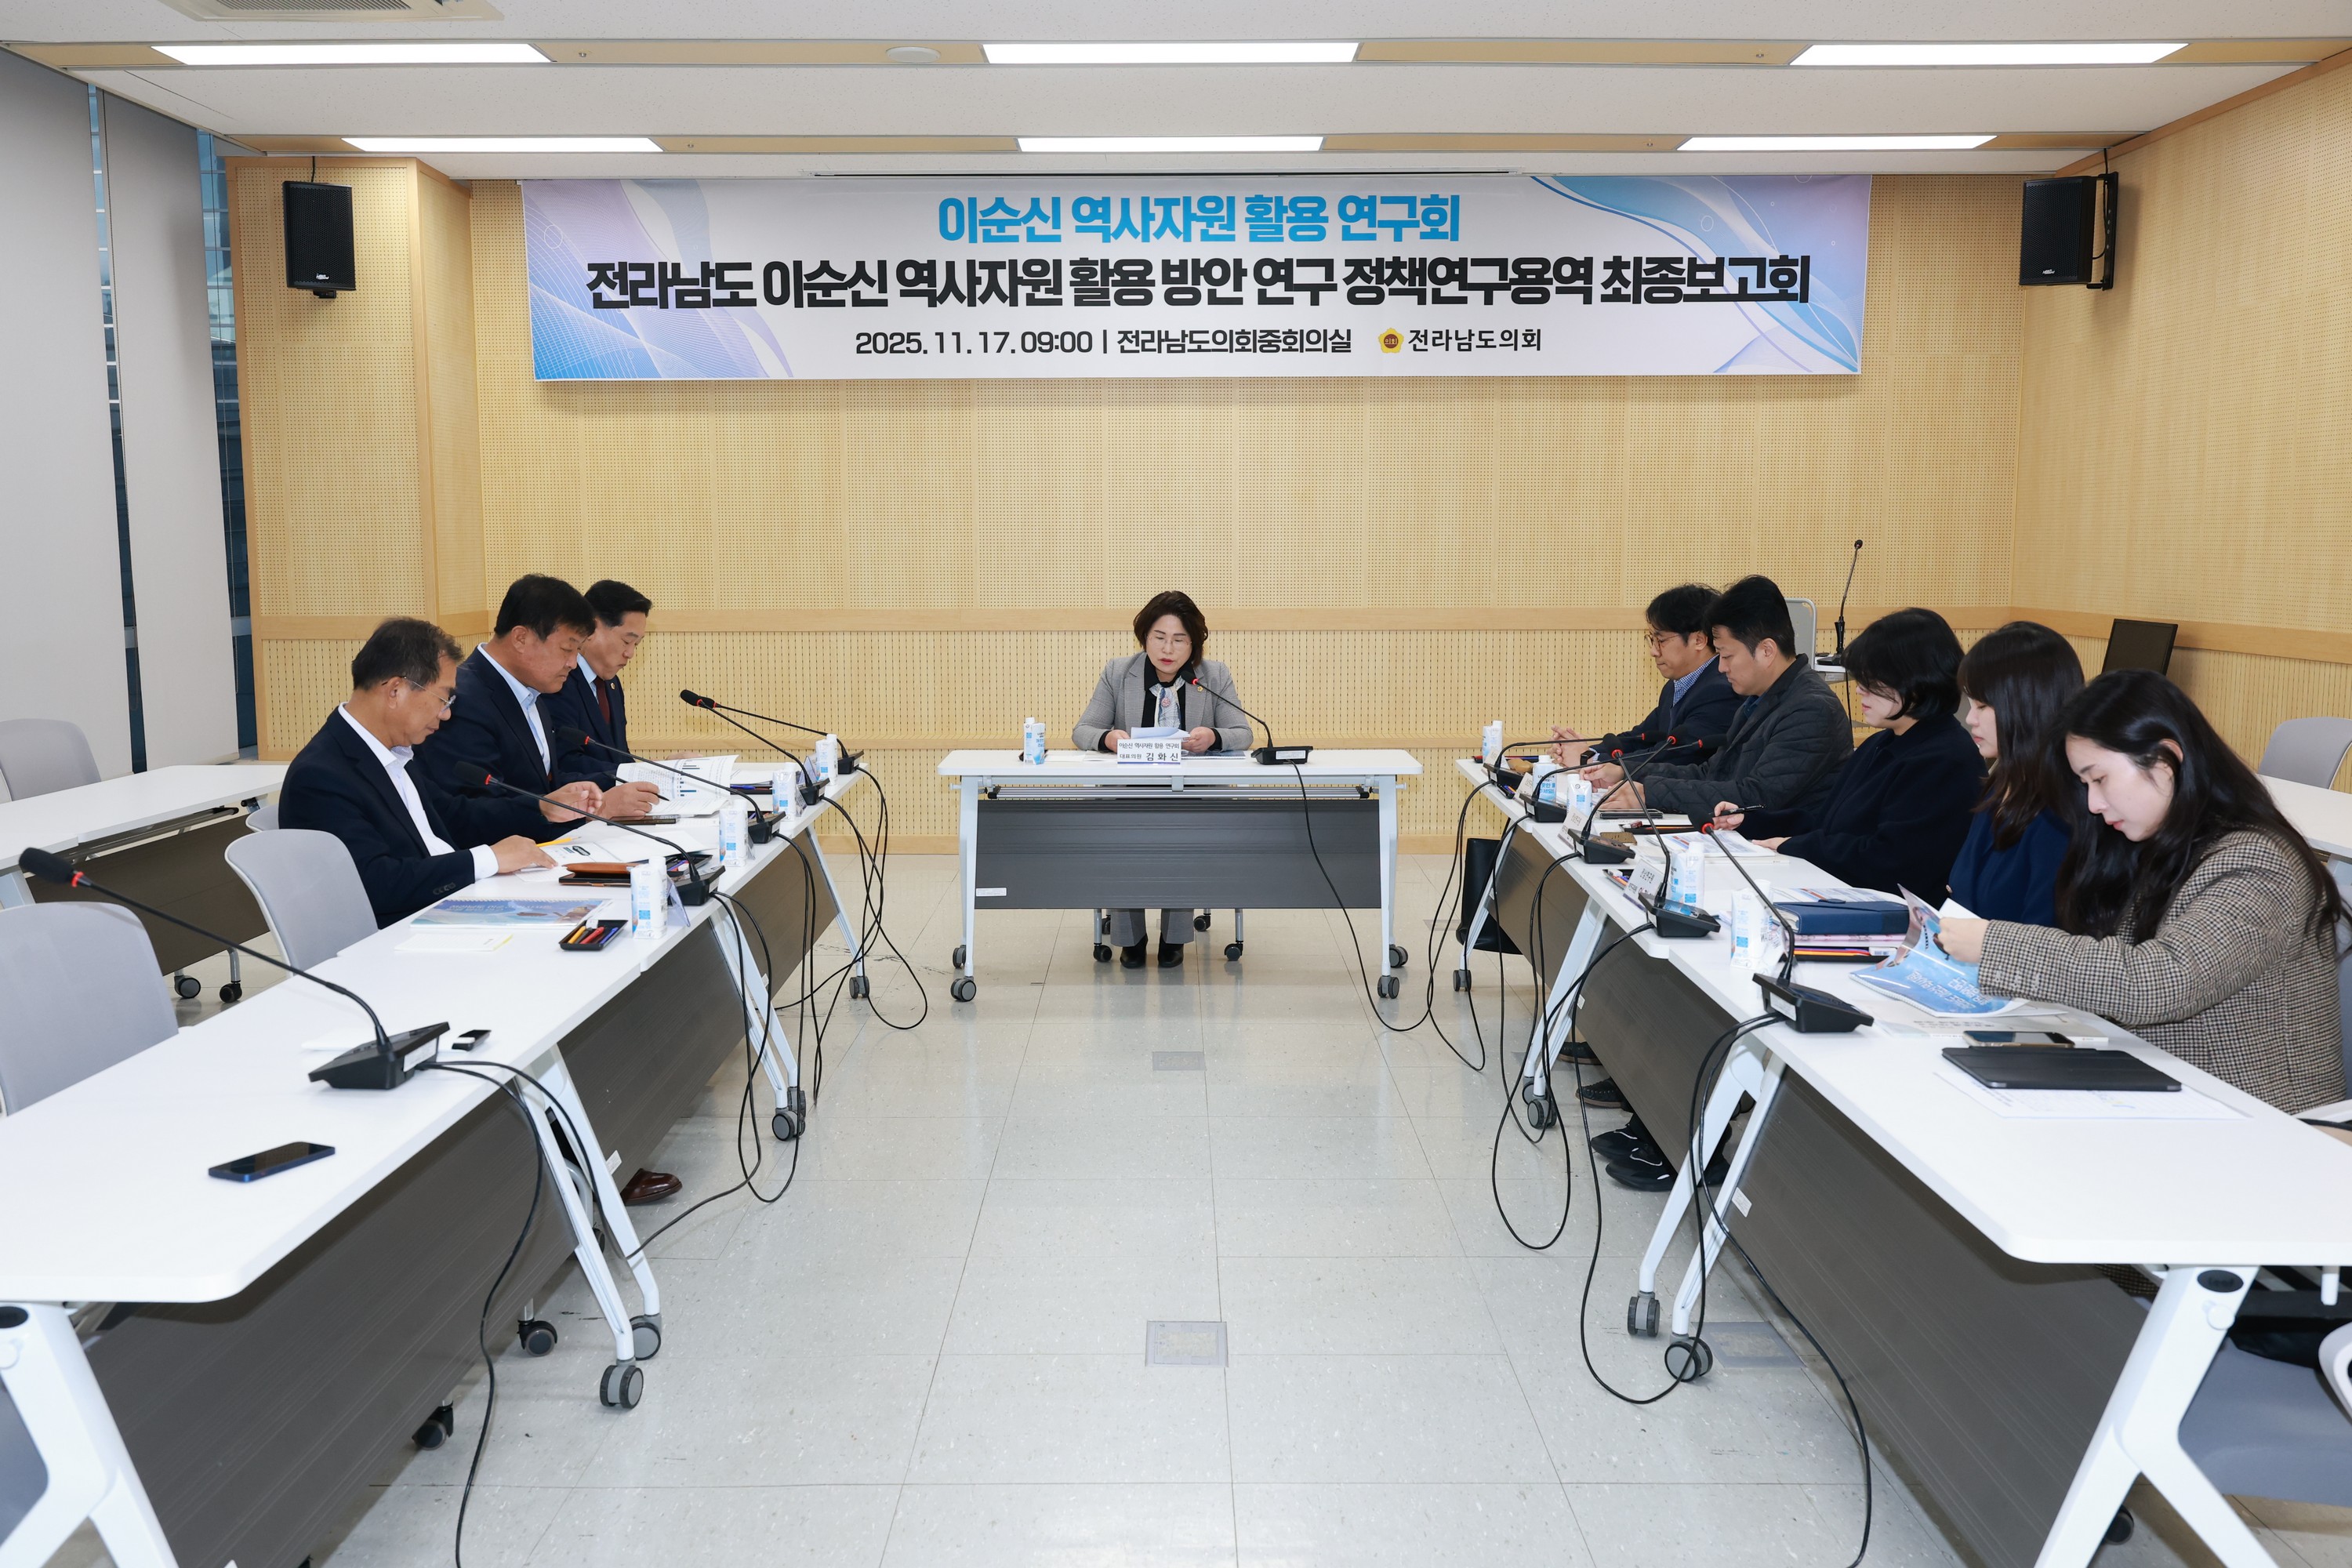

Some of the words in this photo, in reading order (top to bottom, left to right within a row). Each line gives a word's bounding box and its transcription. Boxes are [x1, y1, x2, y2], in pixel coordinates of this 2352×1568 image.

[938, 196, 1062, 244] 이순신
[1071, 195, 1236, 243] 역사자원
[1244, 194, 1329, 242] 활용
[1338, 194, 1461, 242] 연구회
[586, 261, 757, 310] 전라남도
[763, 260, 888, 308] 이순신
[895, 258, 1063, 308] 역사자원
[1069, 257, 1156, 307] 활용
[1161, 258, 1248, 307] 방안
[1253, 257, 1338, 307] 연구
[1342, 256, 1594, 306] 정책연구용역
[1600, 254, 1810, 305] 최종보고회
[1117, 328, 1352, 354] 전라남도의회중회의실
[1384, 337, 1398, 346] 의회
[1408, 328, 1541, 352] 전라남도의회
